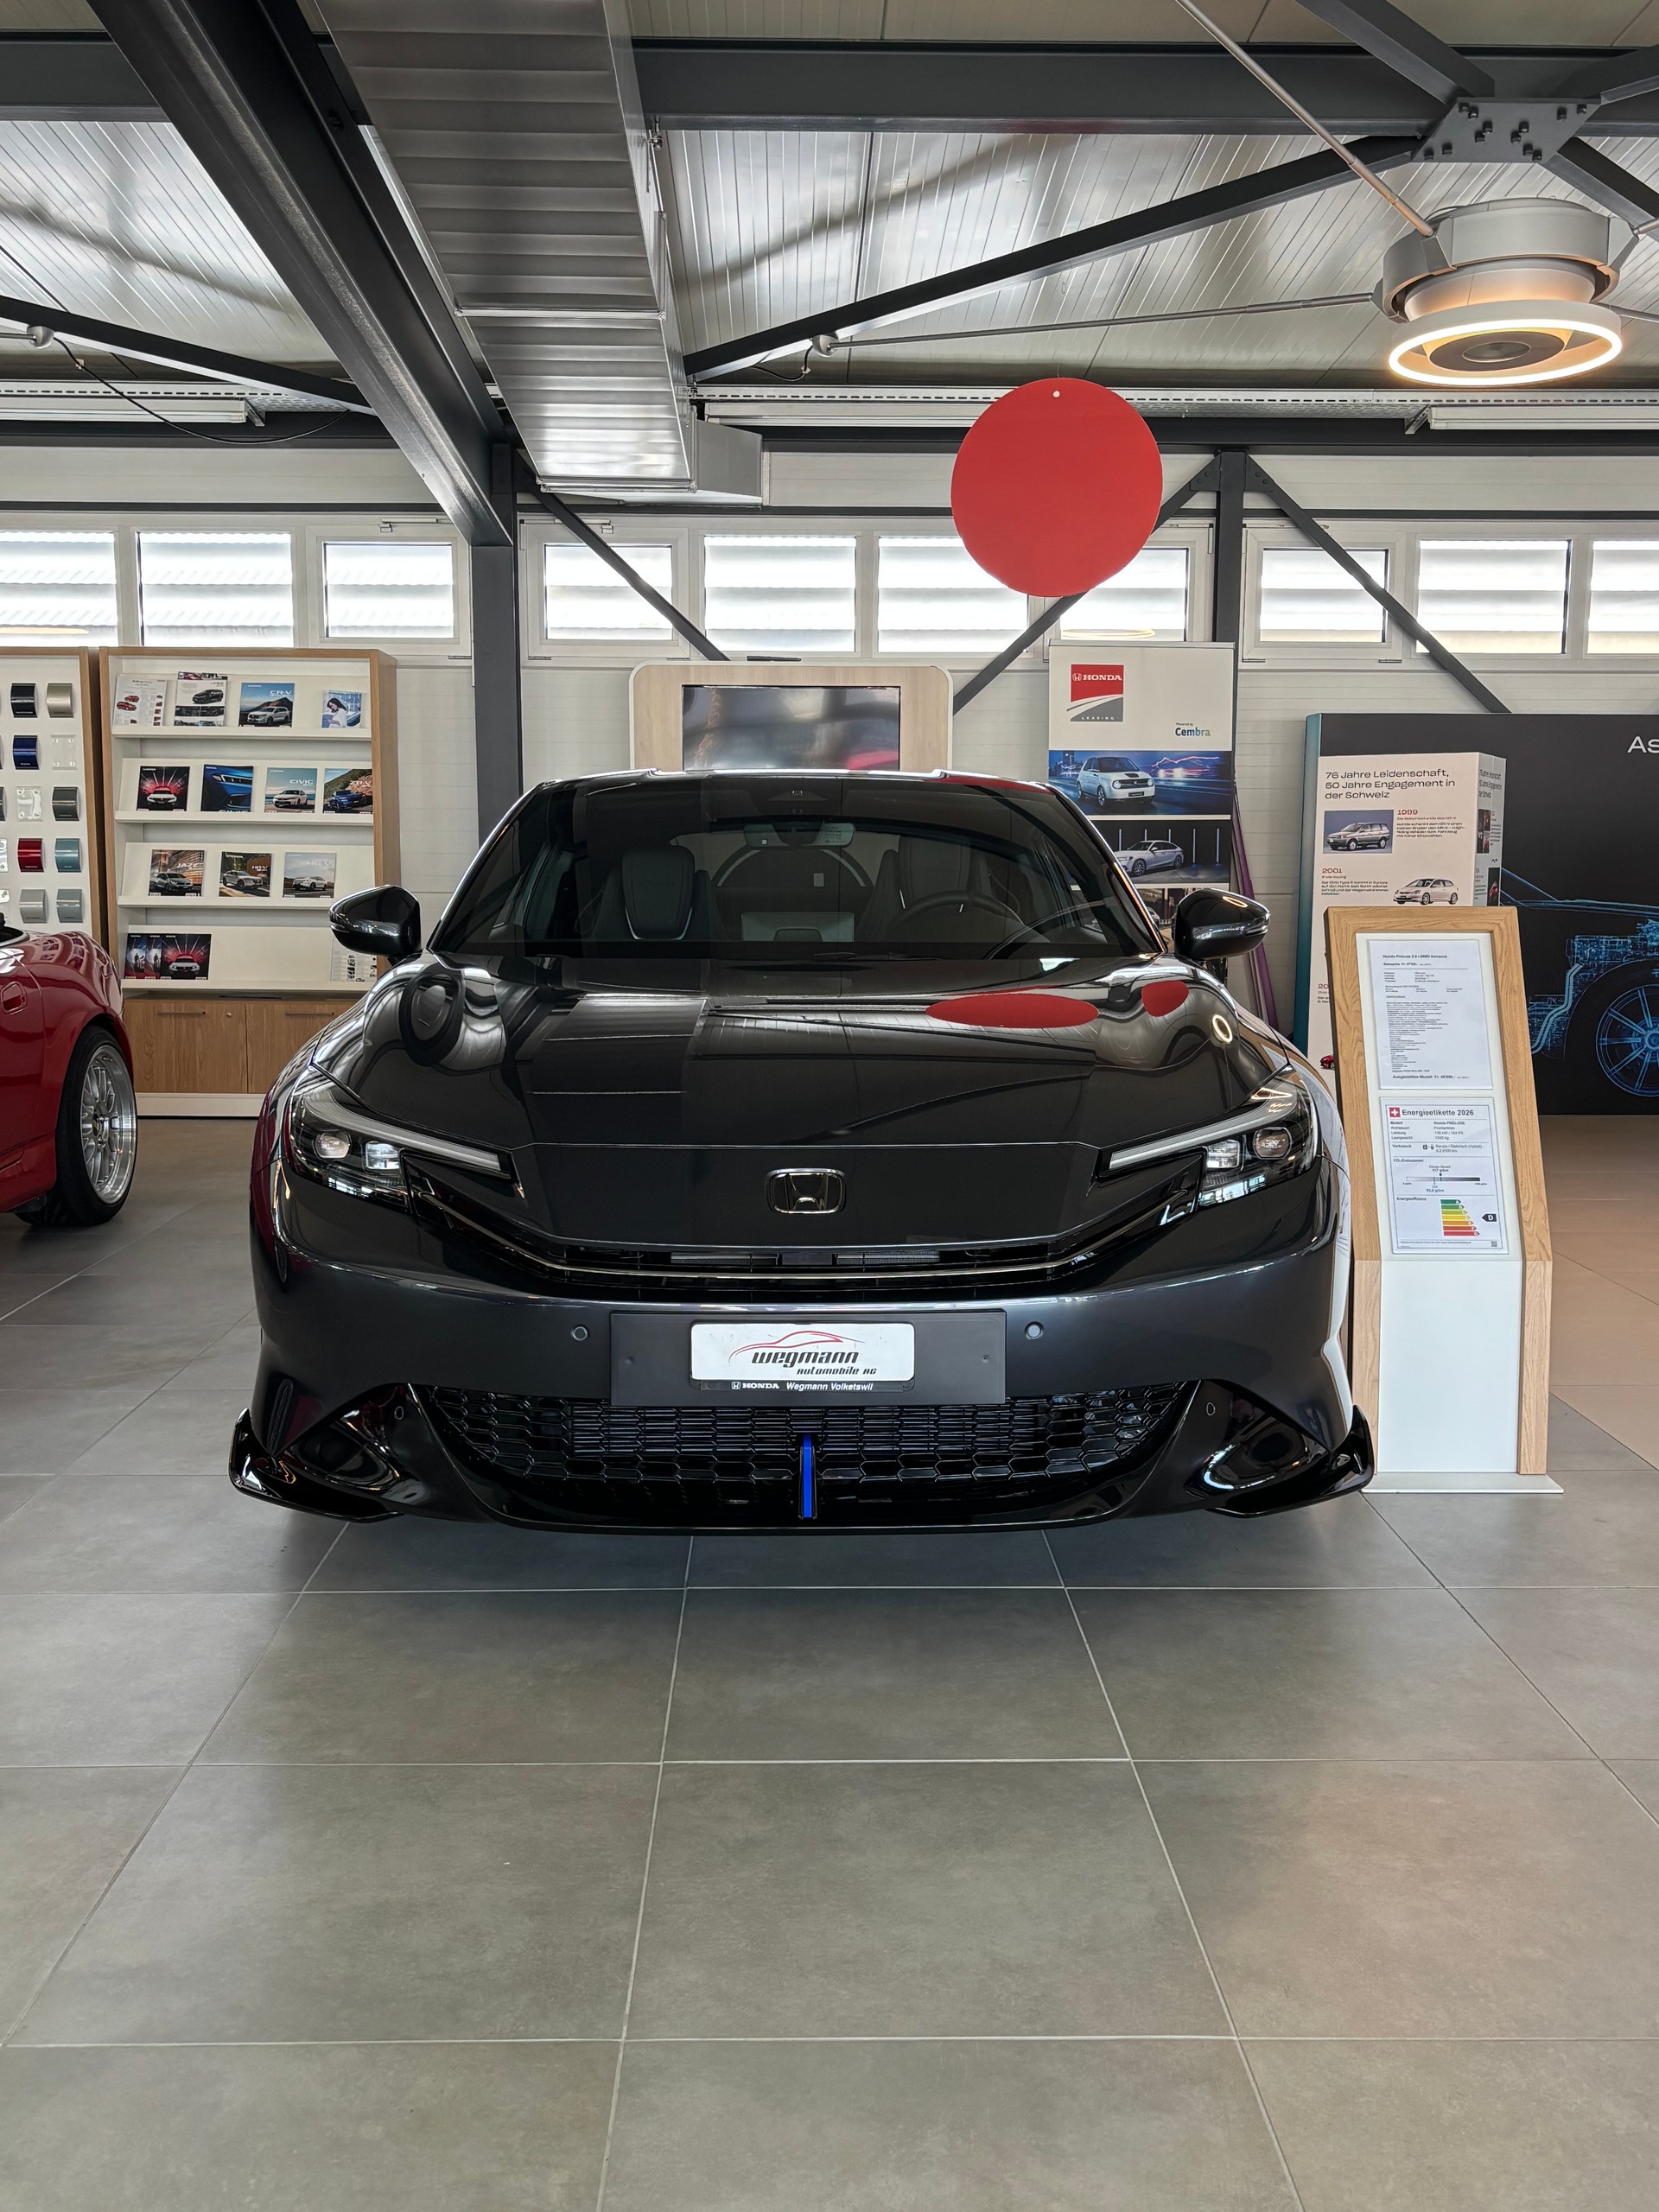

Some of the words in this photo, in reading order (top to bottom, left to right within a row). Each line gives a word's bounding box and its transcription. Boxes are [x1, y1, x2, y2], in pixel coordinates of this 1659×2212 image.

[1175, 727, 1211, 737] Cembra
[1374, 769, 1449, 778] Leidenschaft,
[1374, 780, 1443, 790] Engagement
[751, 1352, 859, 1368] wegmann
[786, 1382, 828, 1391] Wegmann
